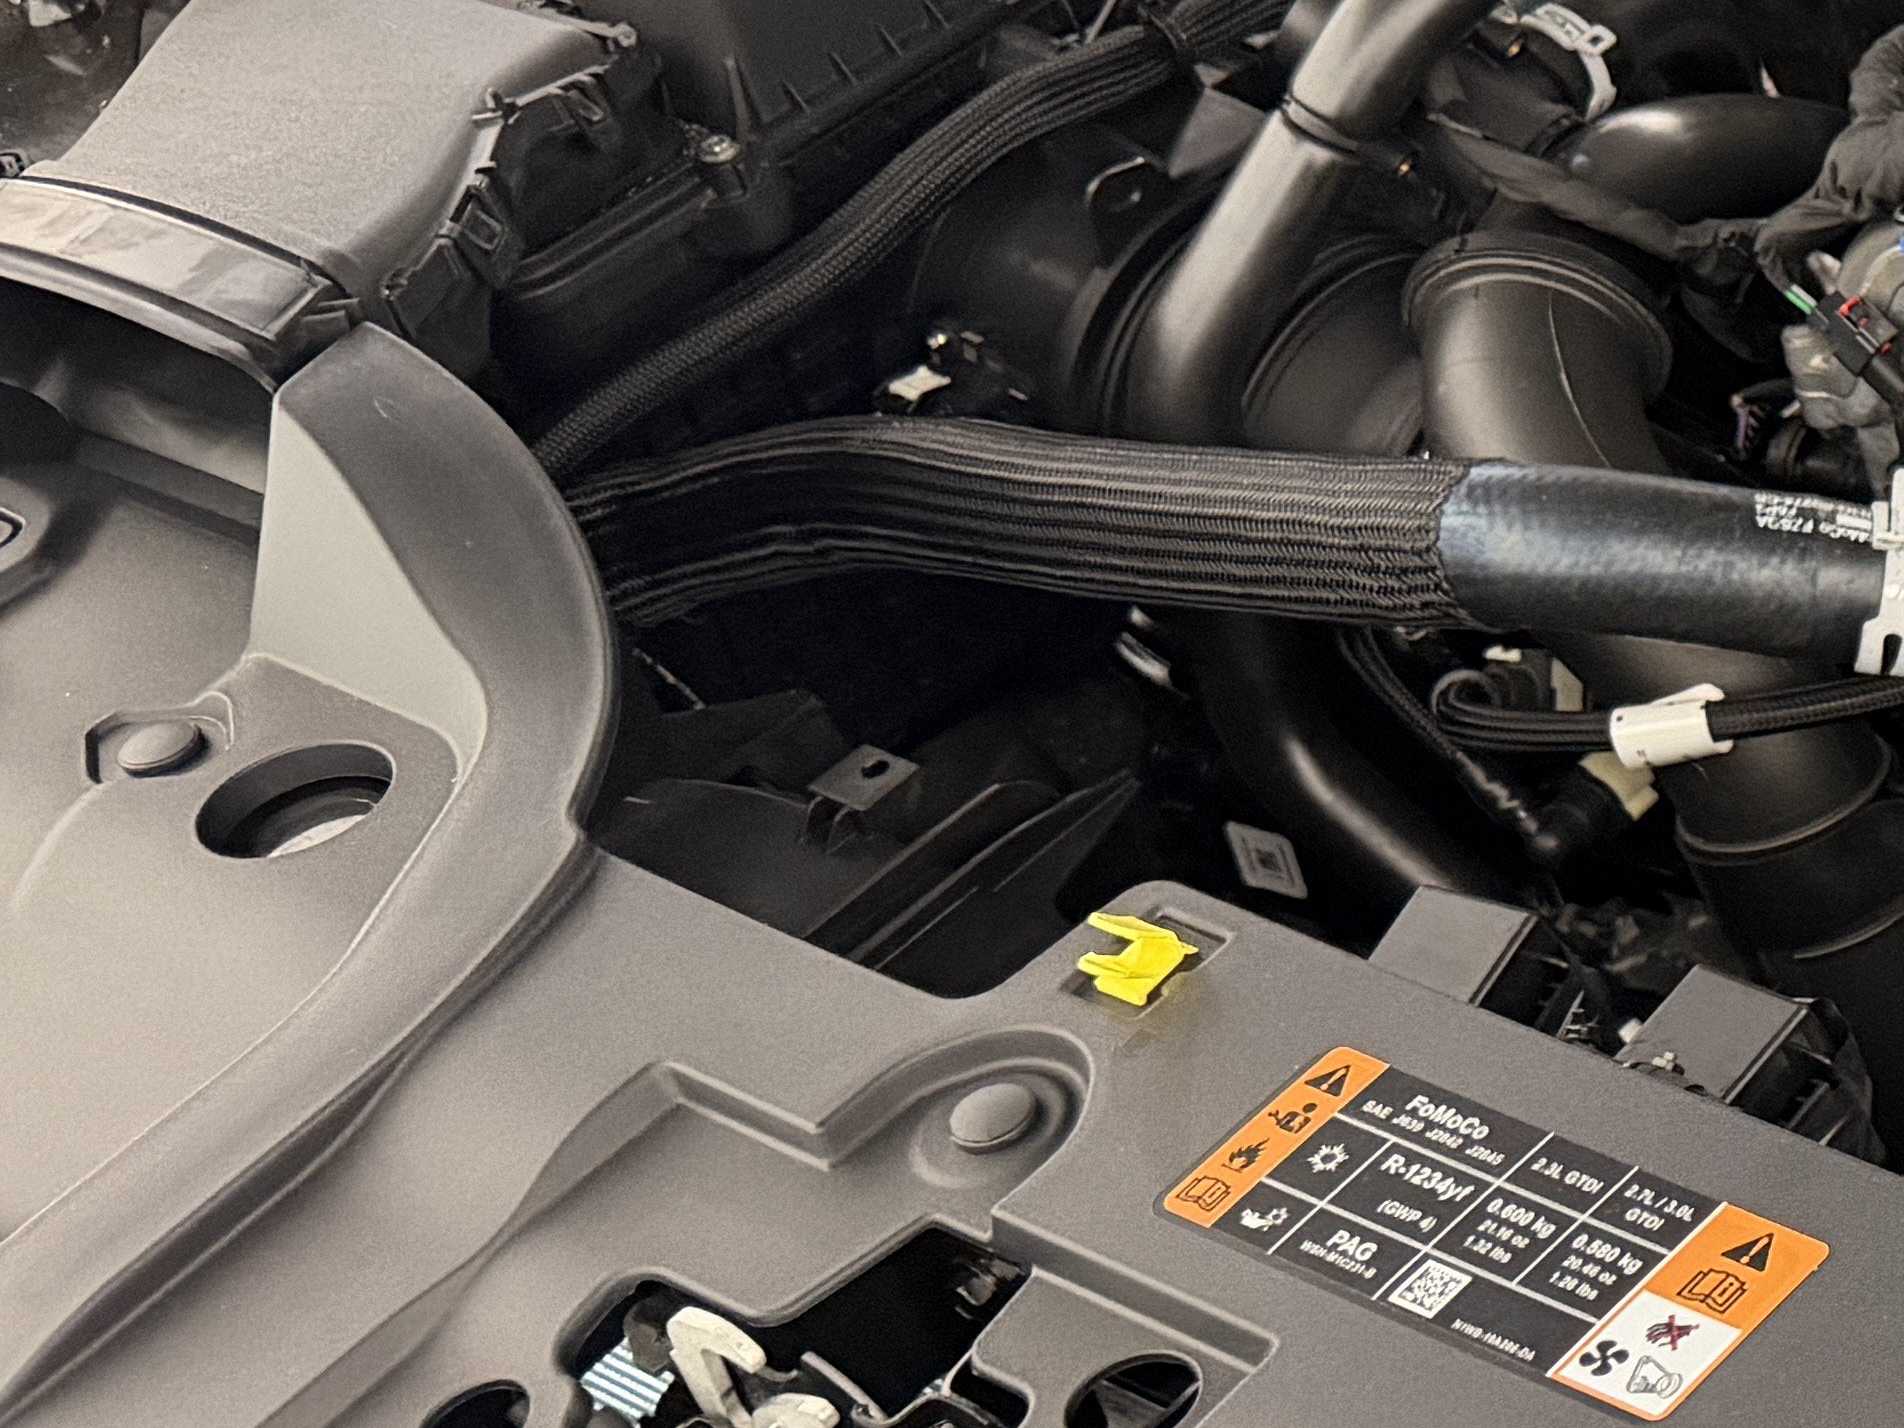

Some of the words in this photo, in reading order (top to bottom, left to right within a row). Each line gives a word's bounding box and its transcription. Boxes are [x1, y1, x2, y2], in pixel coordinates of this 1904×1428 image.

[1361, 1099, 1393, 1120] SAE
[1405, 1094, 1490, 1140] FoMoCo
[1380, 1153, 1475, 1202] R-1234yf
[1530, 1157, 1562, 1180] 2.3L
[1563, 1170, 1605, 1194] GTDI
[1377, 1199, 1423, 1223] (GWP
[1419, 1215, 1438, 1233] 4)
[1486, 1198, 1535, 1226] 0.600
[1530, 1216, 1557, 1240] kg
[1624, 1207, 1666, 1231] GTDI
[1663, 1199, 1696, 1222] 3.0L
[1325, 1229, 1378, 1261] PAG
[1463, 1235, 1494, 1256] 1.32
[1490, 1247, 1513, 1264] lbs
[1511, 1234, 1530, 1248] oz
[1572, 1233, 1622, 1263] 0.580
[1616, 1252, 1644, 1276] kg
[1575, 1279, 1599, 1301] lbs
[1598, 1271, 1617, 1286] oz
